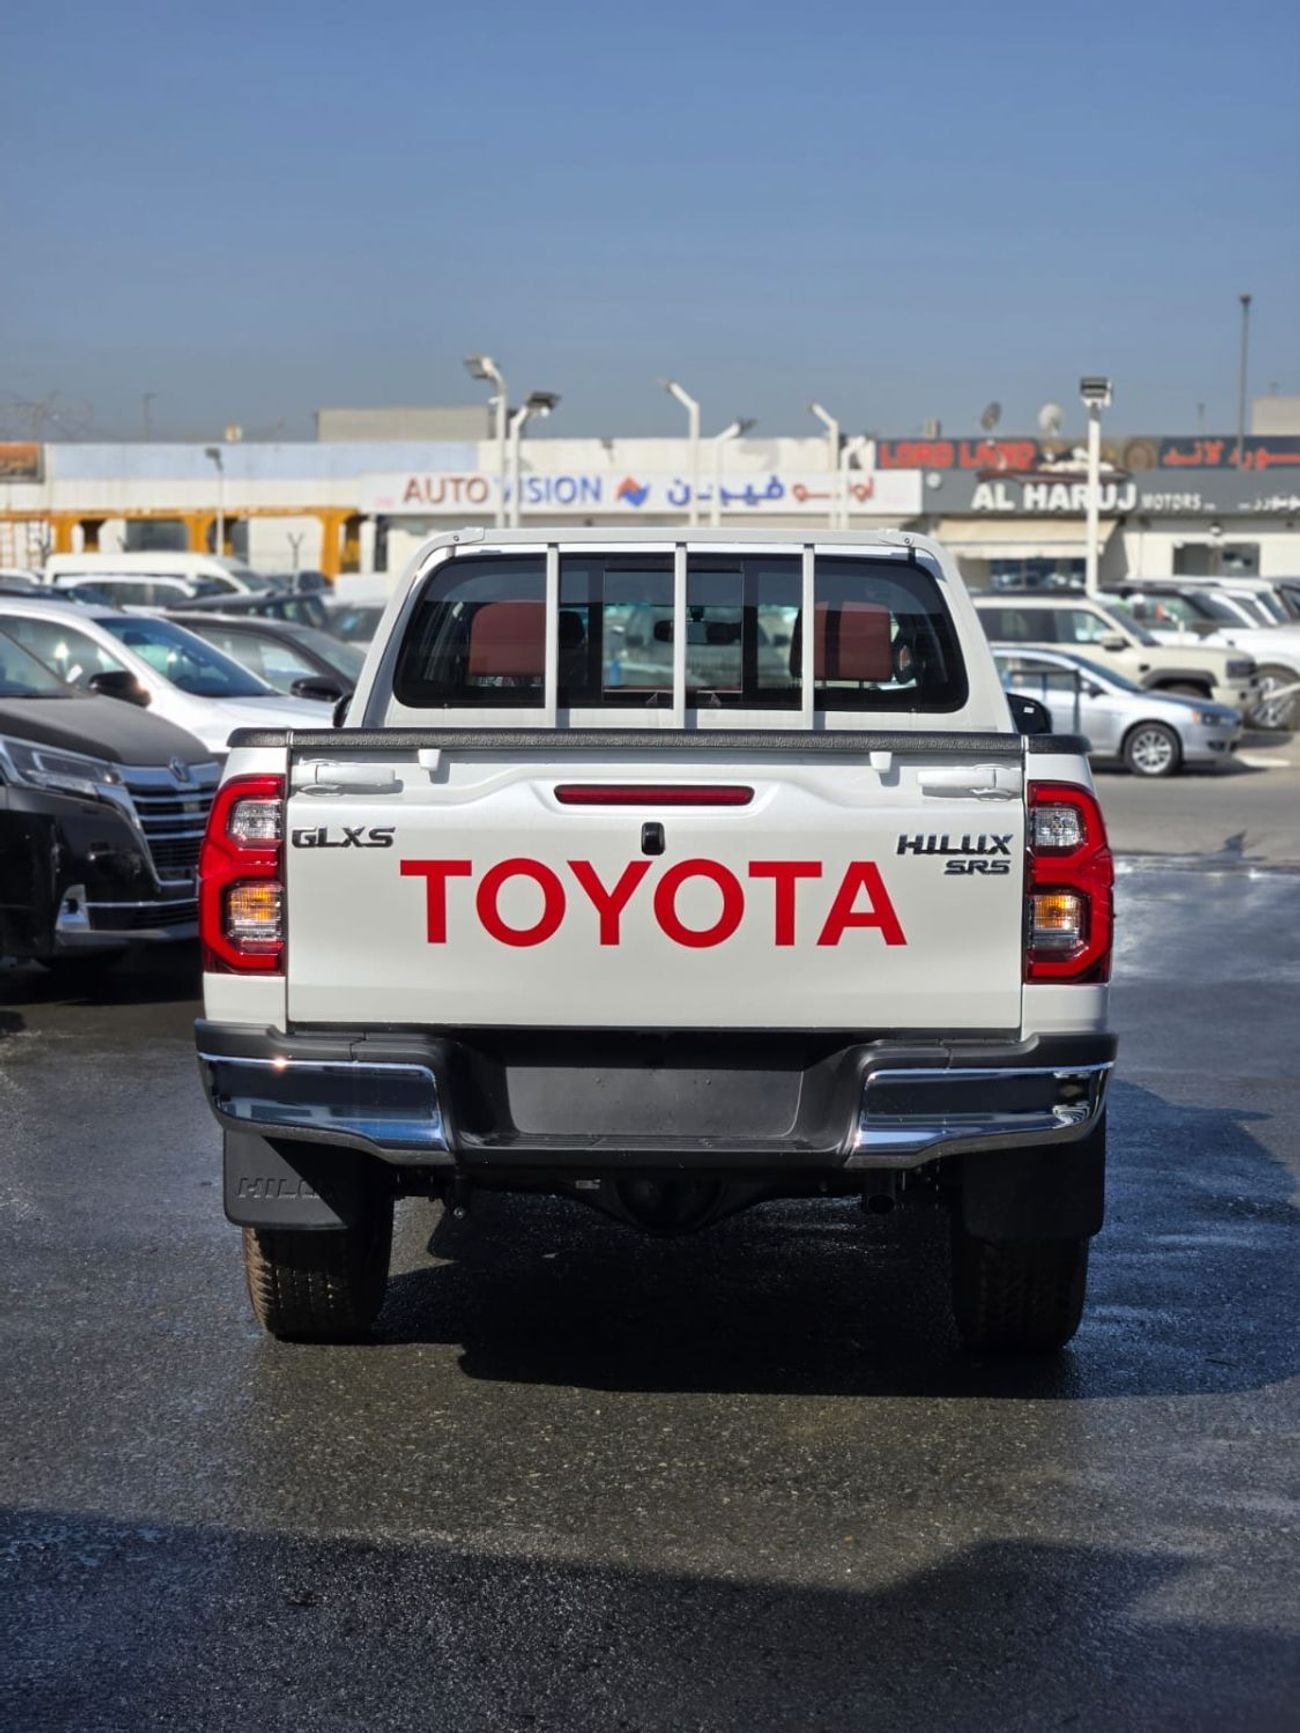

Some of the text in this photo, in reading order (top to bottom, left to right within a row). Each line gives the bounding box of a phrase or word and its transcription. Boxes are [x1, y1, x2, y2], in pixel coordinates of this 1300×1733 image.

[403, 476, 490, 504] AUTO
[970, 482, 1016, 511] AL
[291, 826, 396, 848] GLXS
[896, 834, 1014, 855] HILUX
[400, 857, 907, 948] TOYOTA
[238, 1177, 323, 1199] HILU
